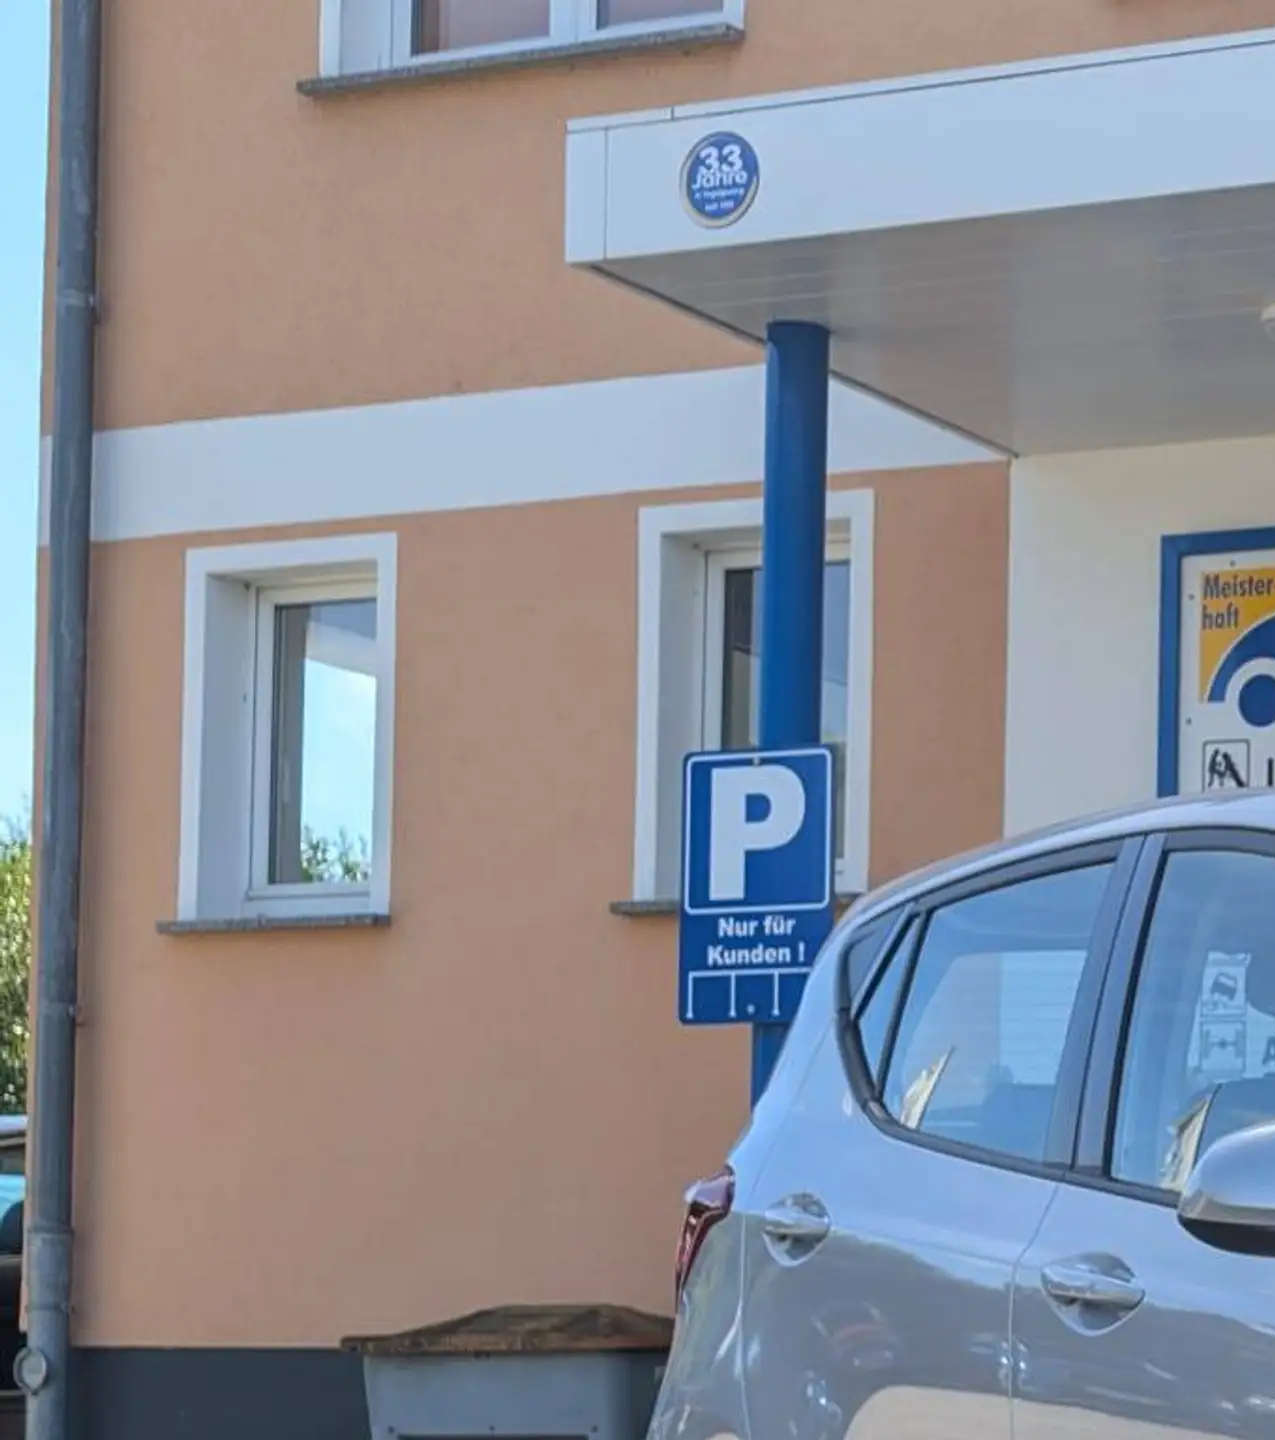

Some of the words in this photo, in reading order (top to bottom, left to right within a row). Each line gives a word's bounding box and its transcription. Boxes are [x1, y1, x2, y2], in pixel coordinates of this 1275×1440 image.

[699, 144, 744, 172] 33
[1202, 605, 1239, 631] haft
[709, 764, 806, 901] P
[718, 916, 760, 938] Nur
[763, 915, 797, 936] für
[707, 942, 792, 967] Kunden
